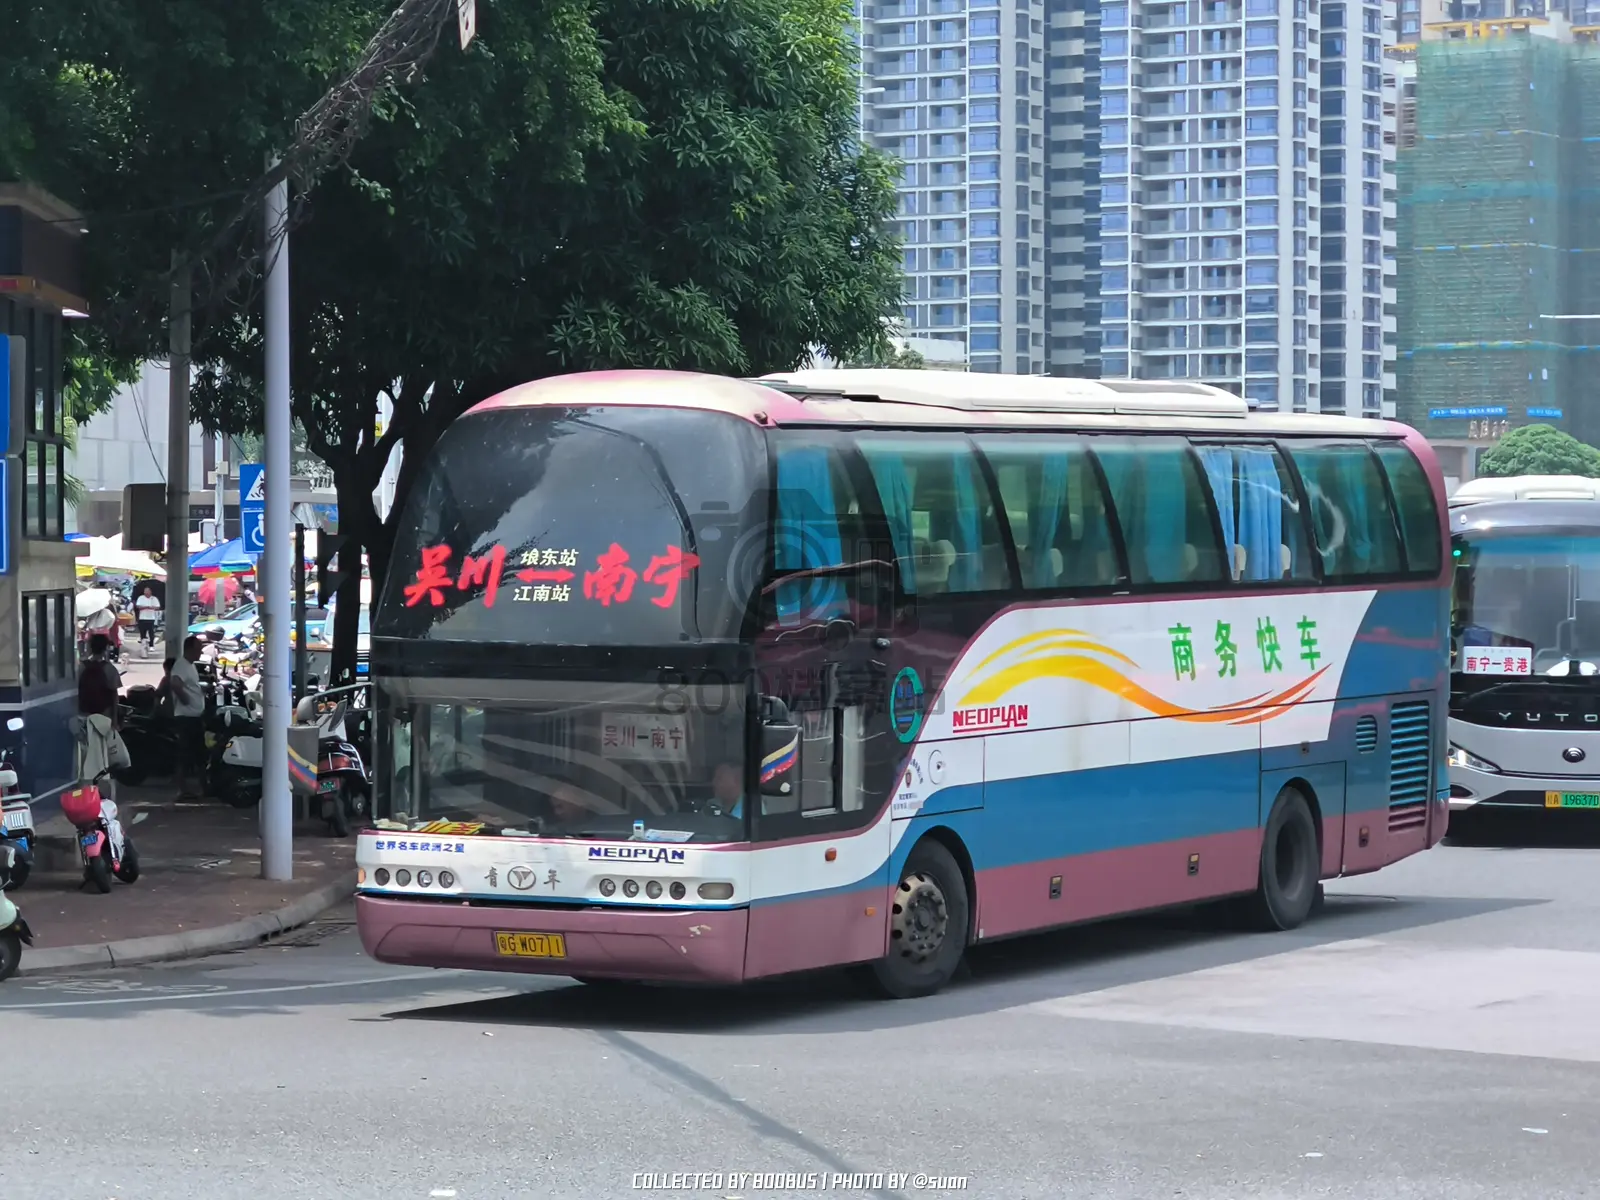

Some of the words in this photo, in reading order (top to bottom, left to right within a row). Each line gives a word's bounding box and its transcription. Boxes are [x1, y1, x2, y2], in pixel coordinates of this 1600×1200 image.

[520, 548, 579, 566] 埌东站
[403, 543, 507, 609] 吴川
[582, 542, 701, 609] 南宁
[512, 584, 571, 602] 江南站
[1167, 614, 1322, 681] 商务快车
[952, 704, 1028, 733] NEOPLAN
[1498, 712, 1598, 722] YUTO
[375, 840, 465, 854] 世界名车欧洲之星
[588, 846, 684, 863] NEOPLAN
